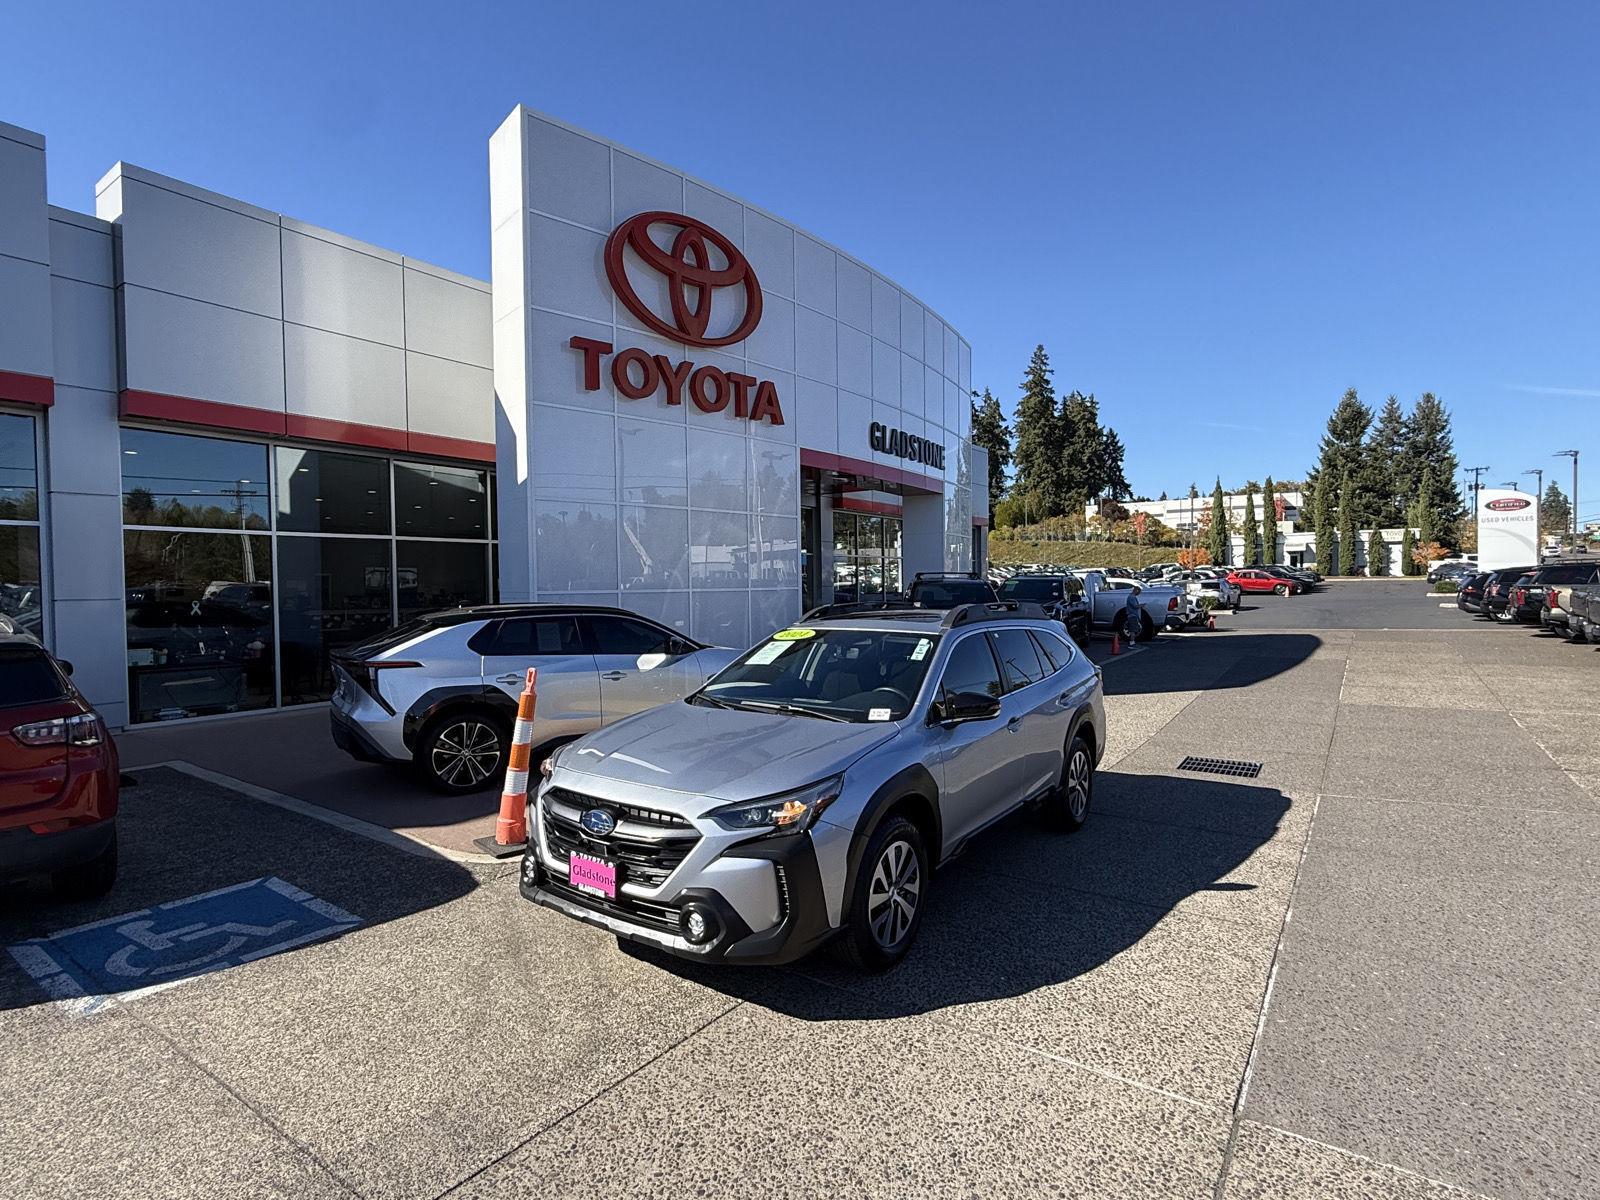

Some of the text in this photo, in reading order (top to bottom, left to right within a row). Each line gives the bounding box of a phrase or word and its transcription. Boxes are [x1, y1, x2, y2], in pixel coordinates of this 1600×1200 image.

[570, 336, 785, 426] TOYOTA
[870, 421, 945, 470] GLADSTONE
[573, 864, 615, 886] Gladstone
